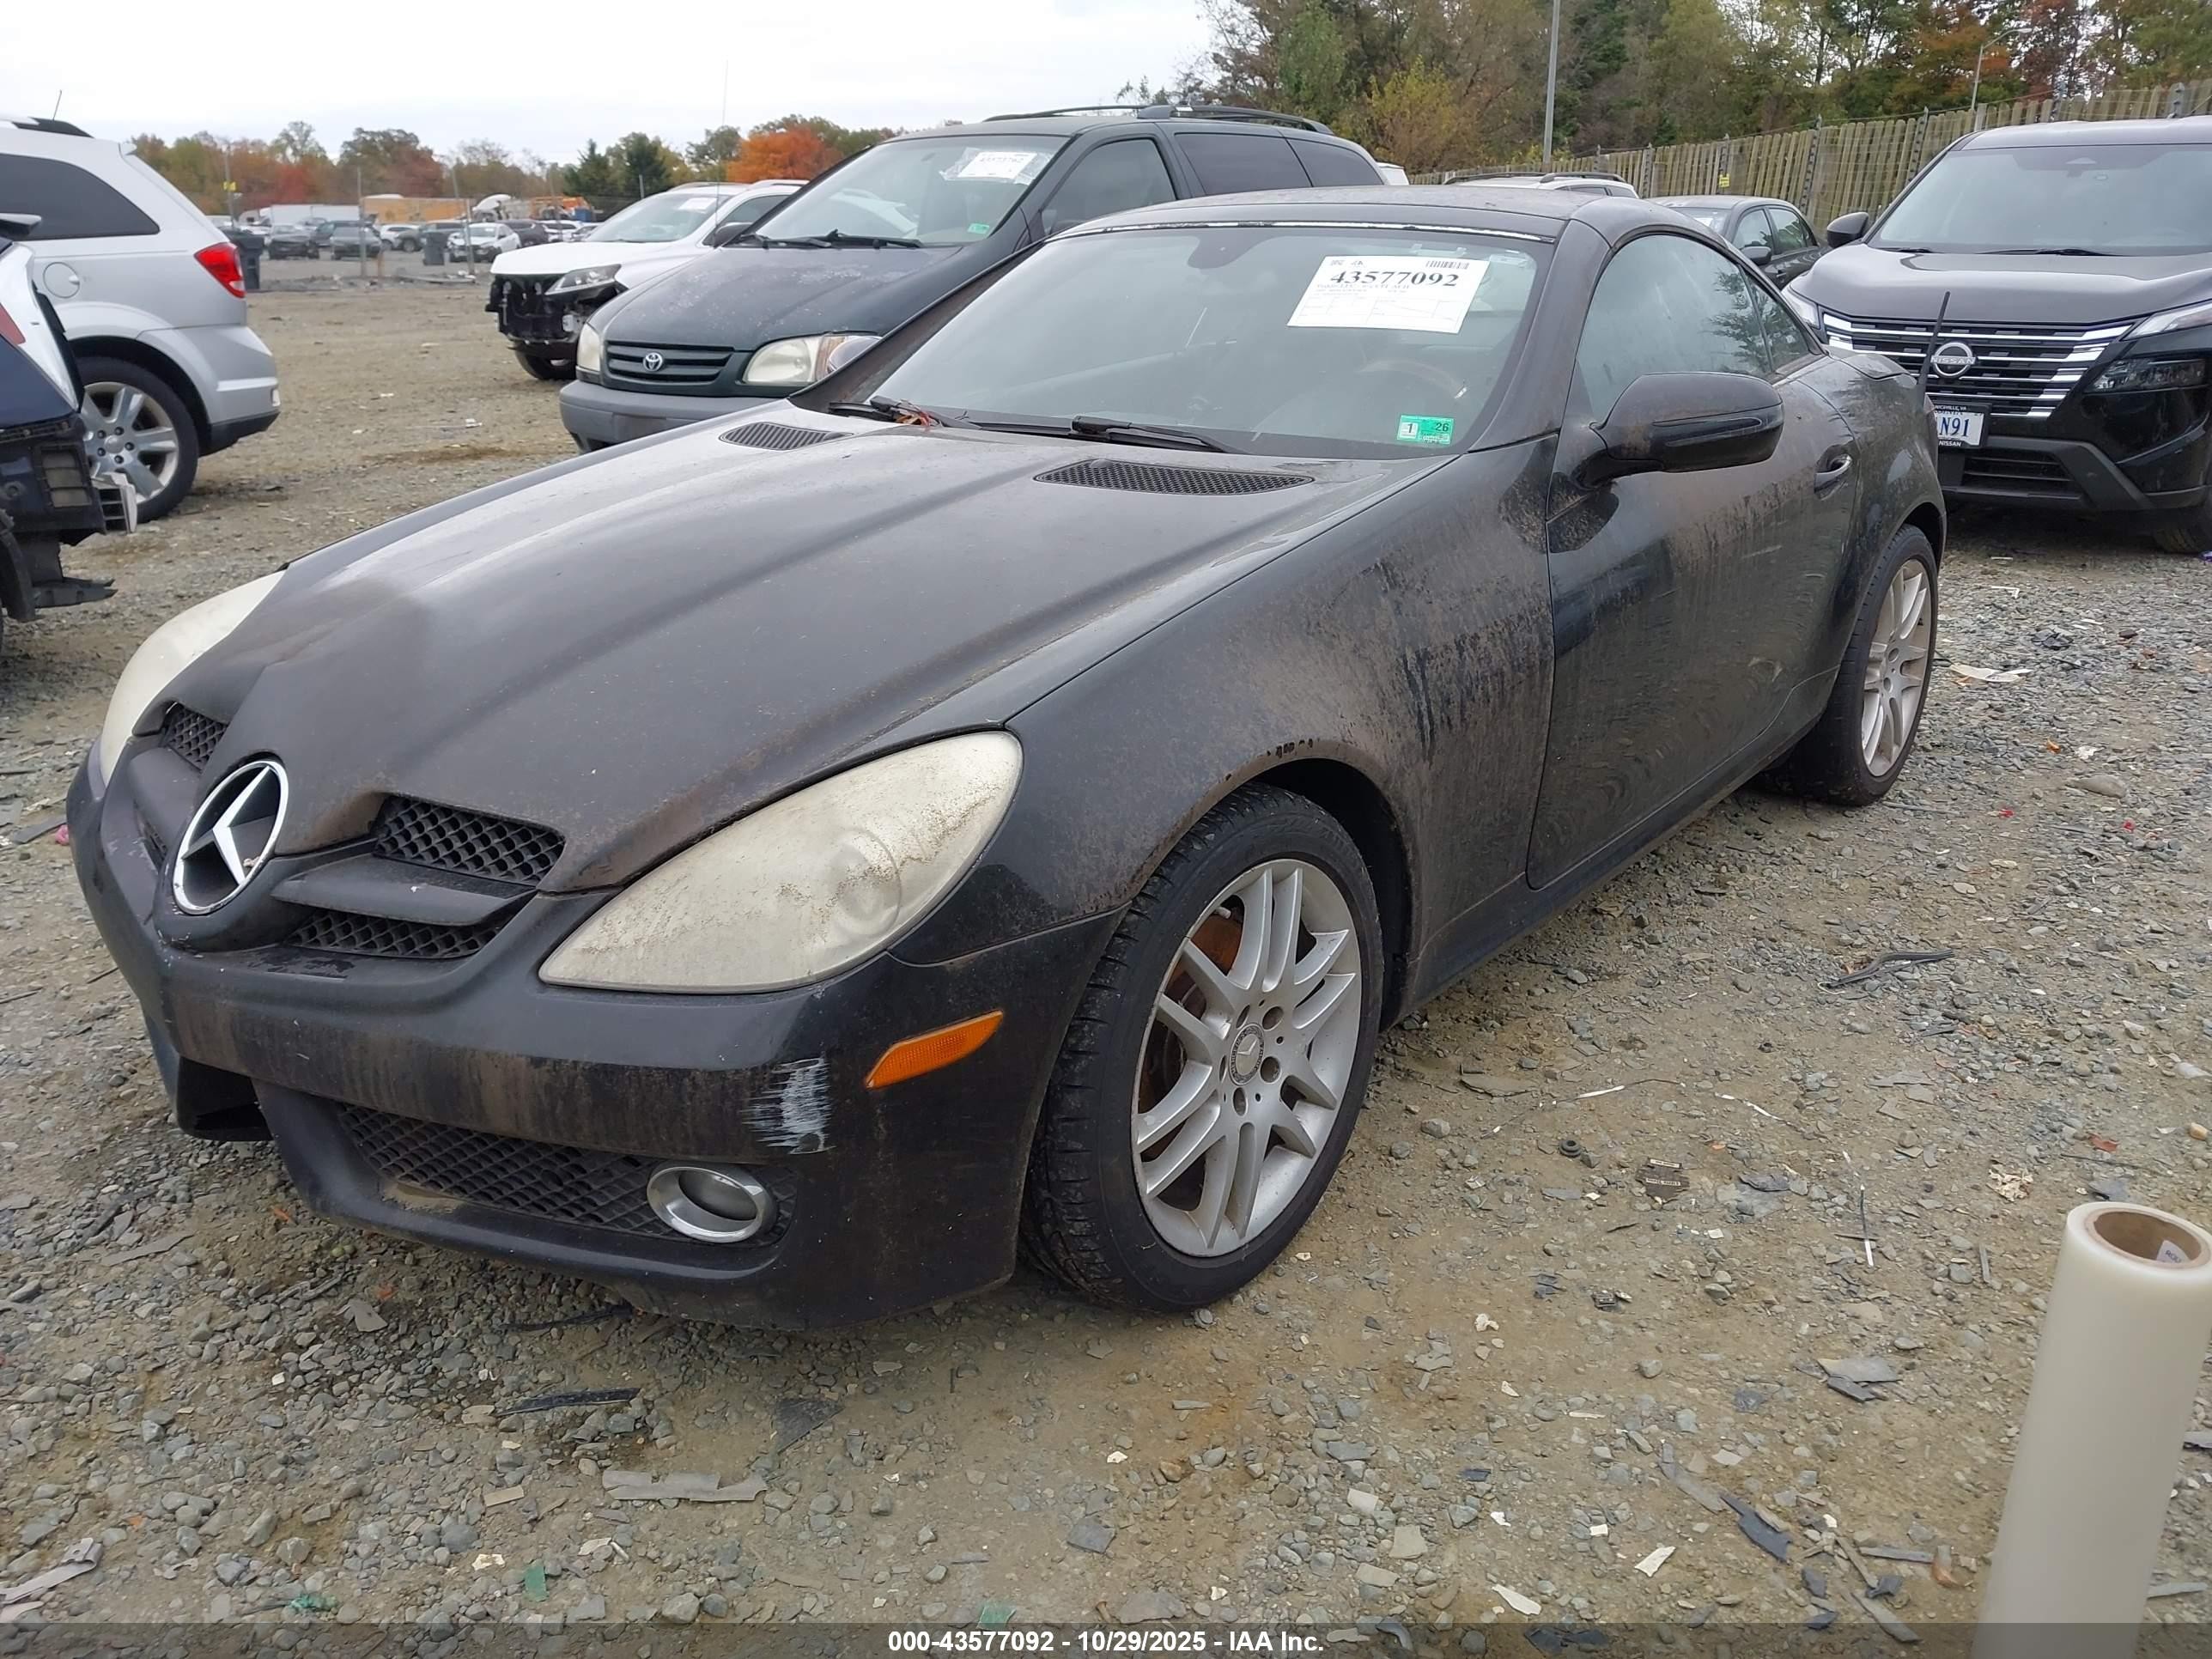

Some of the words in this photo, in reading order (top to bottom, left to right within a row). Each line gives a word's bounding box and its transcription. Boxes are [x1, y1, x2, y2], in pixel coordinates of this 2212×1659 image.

[1330, 270, 1460, 287] 43577092
[1930, 356, 1976, 365] NISSAN
[1435, 422, 1449, 432] 26
